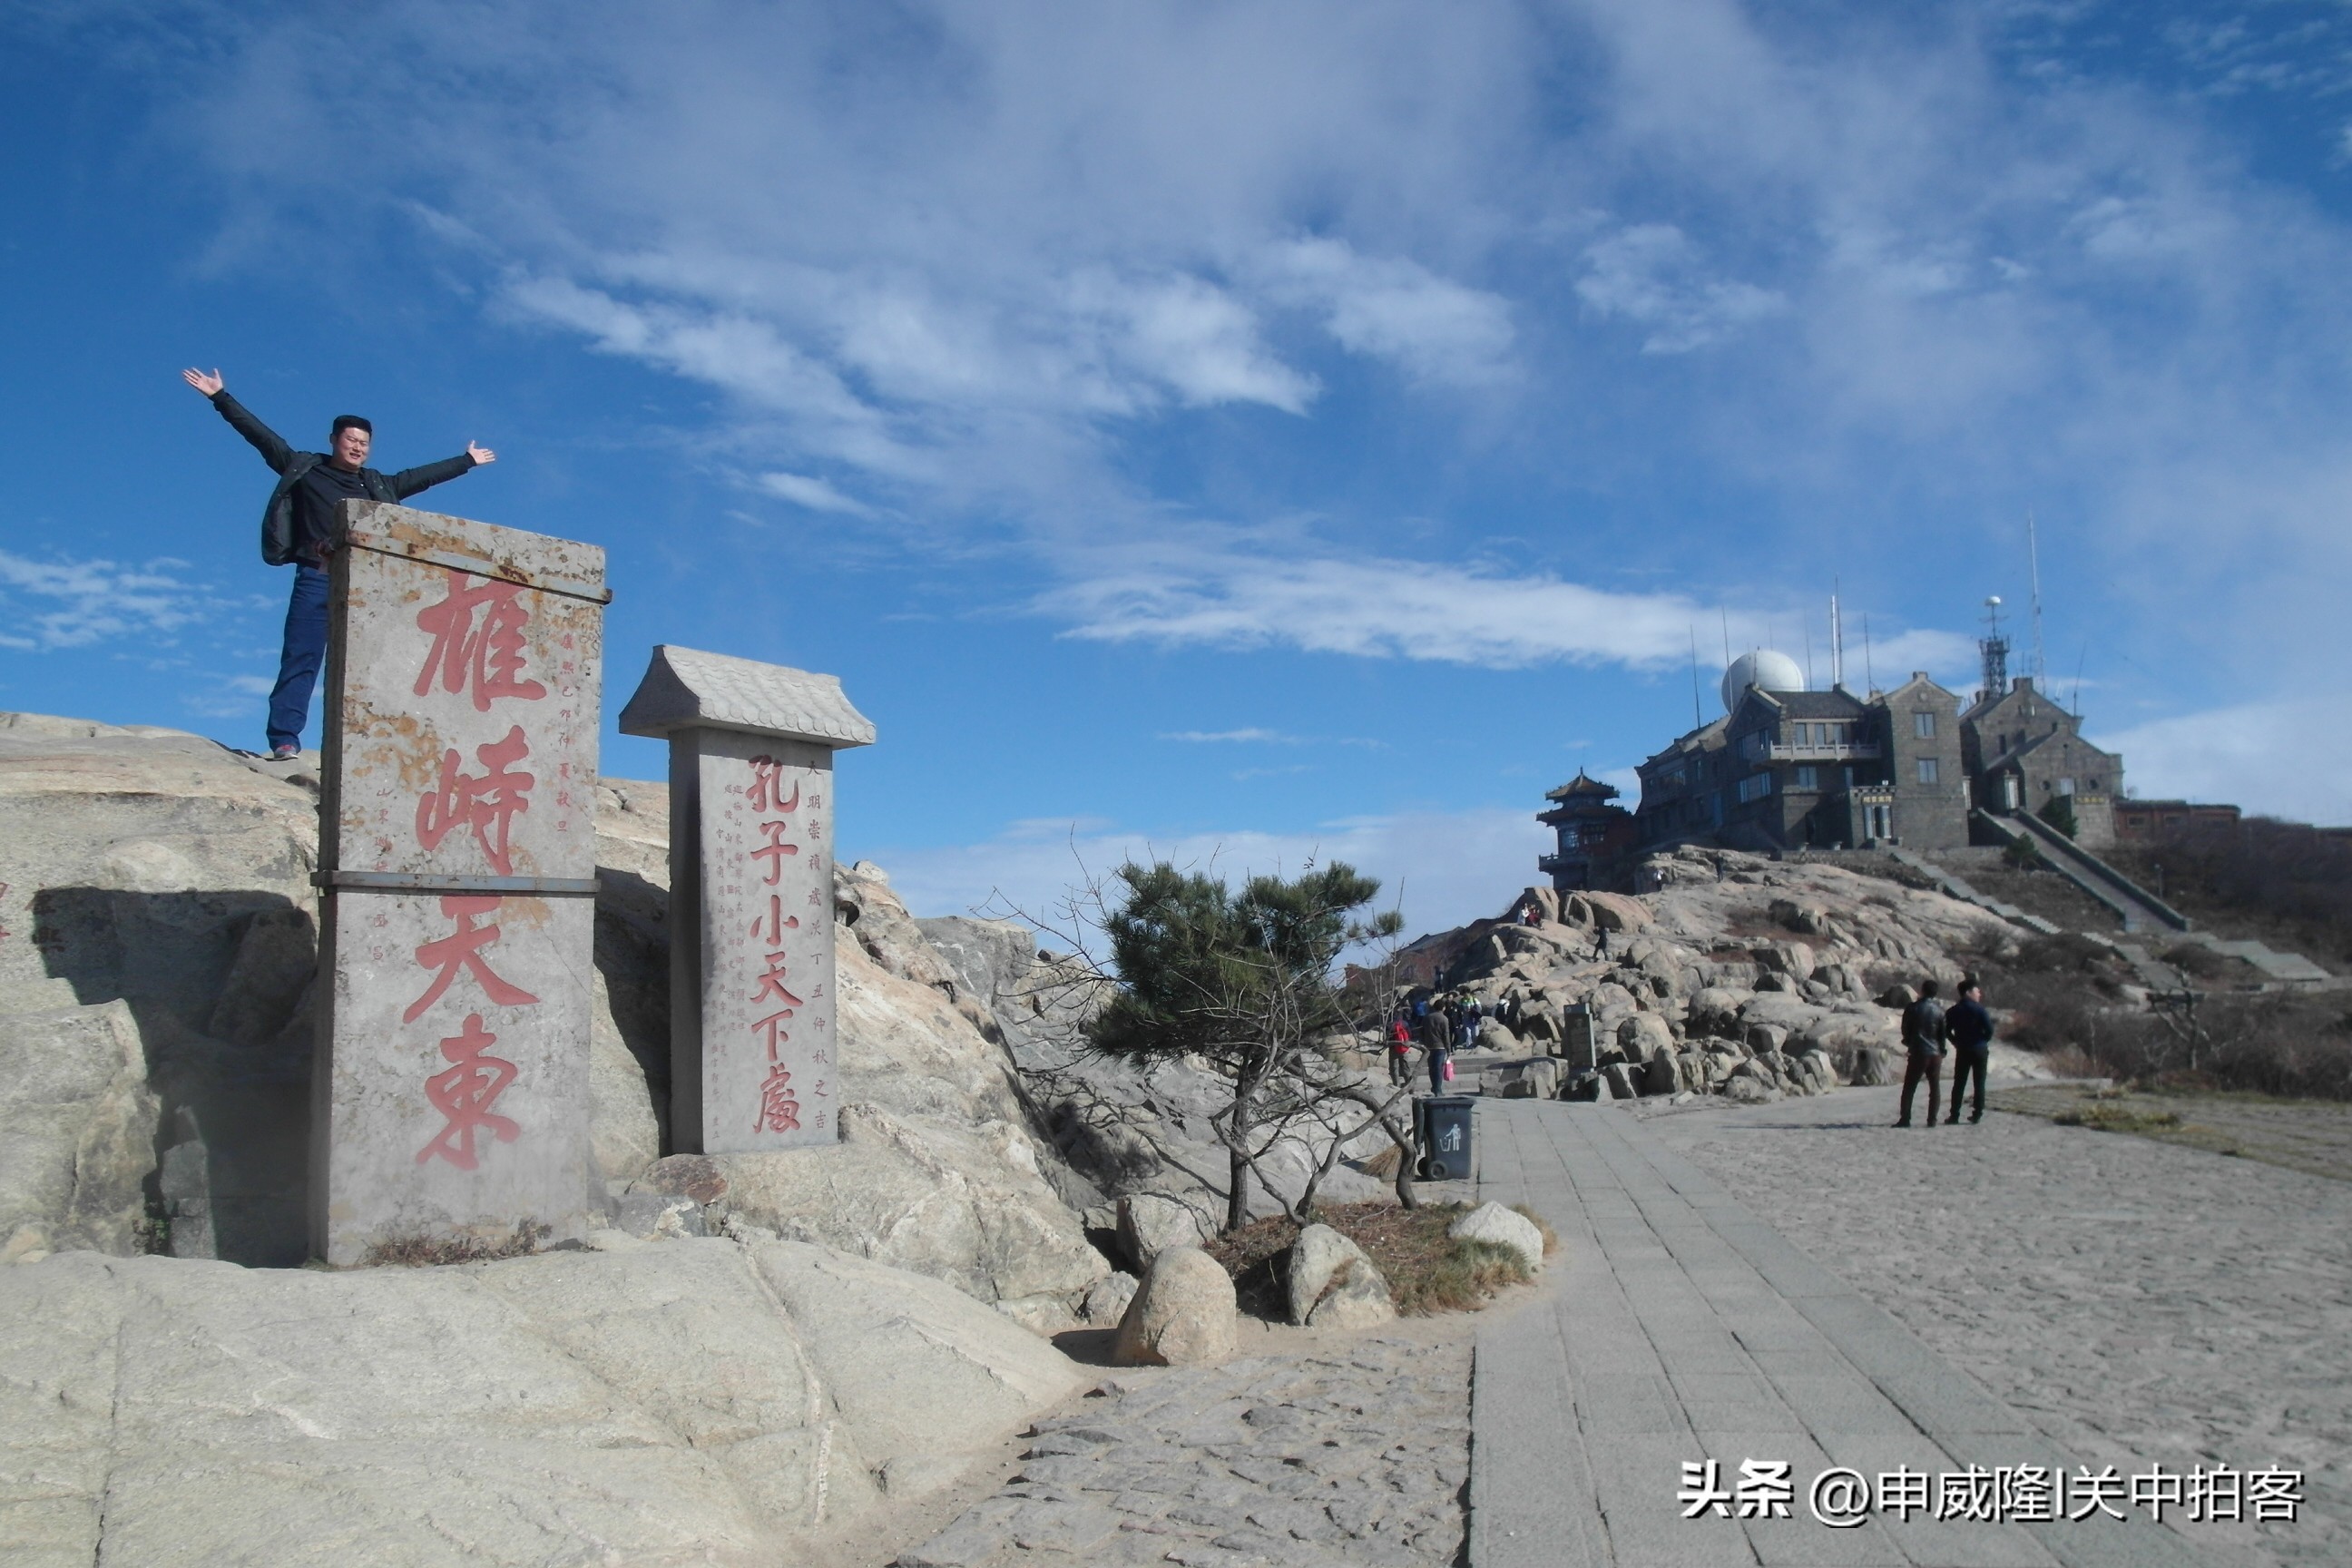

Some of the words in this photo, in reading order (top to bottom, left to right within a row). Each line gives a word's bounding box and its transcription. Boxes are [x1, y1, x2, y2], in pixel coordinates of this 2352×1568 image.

[403, 569, 547, 1171] 雄峙天東
[745, 754, 804, 1133] 孔子小天下處
